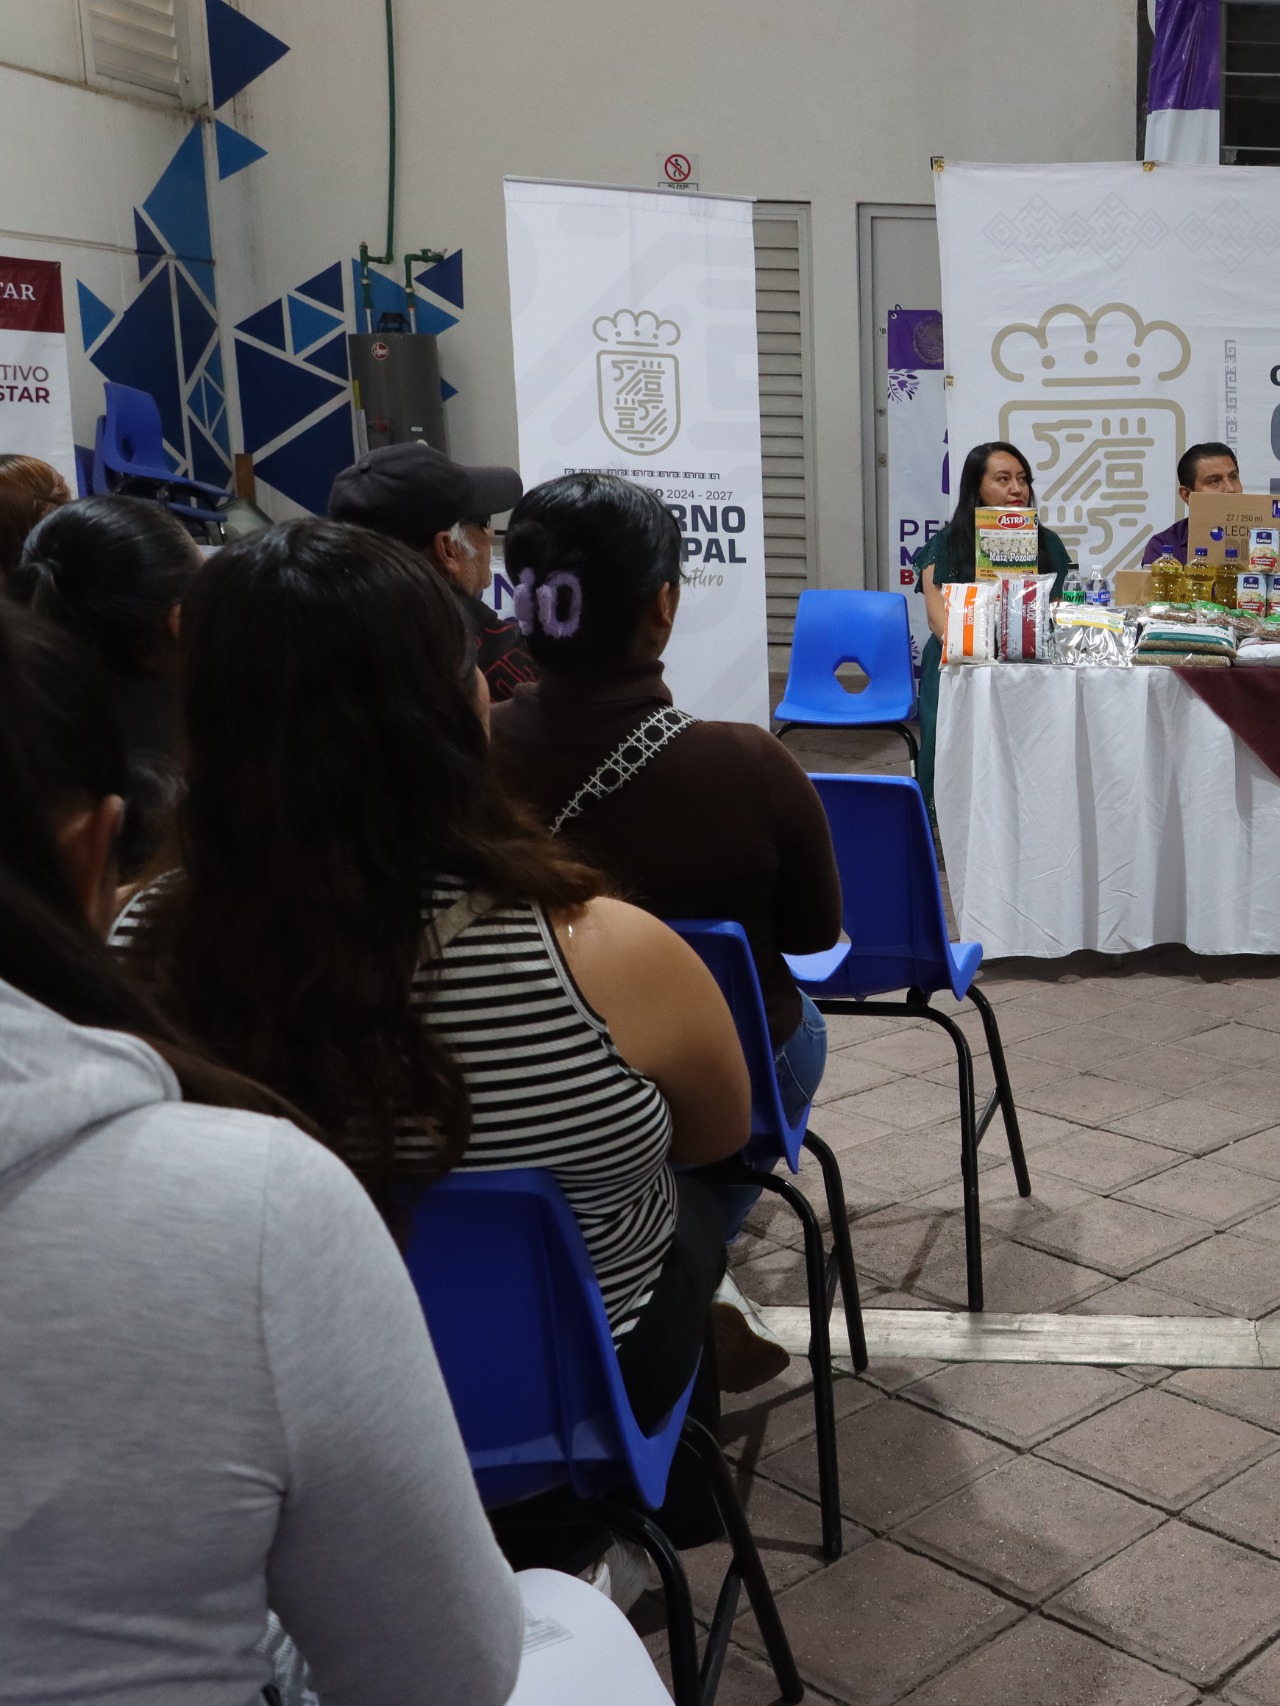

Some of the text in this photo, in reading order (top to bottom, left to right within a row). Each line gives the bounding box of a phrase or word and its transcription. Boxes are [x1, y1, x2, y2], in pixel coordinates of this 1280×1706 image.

[666, 489, 695, 499] 2024
[706, 490, 733, 501] 2027
[1000, 515, 1023, 525] ASTRA
[1226, 513, 1235, 522] 27
[1240, 514, 1254, 523] 250
[1225, 526, 1251, 537] LEC
[1225, 538, 1250, 562] DI
[989, 551, 1008, 562] Maíz
